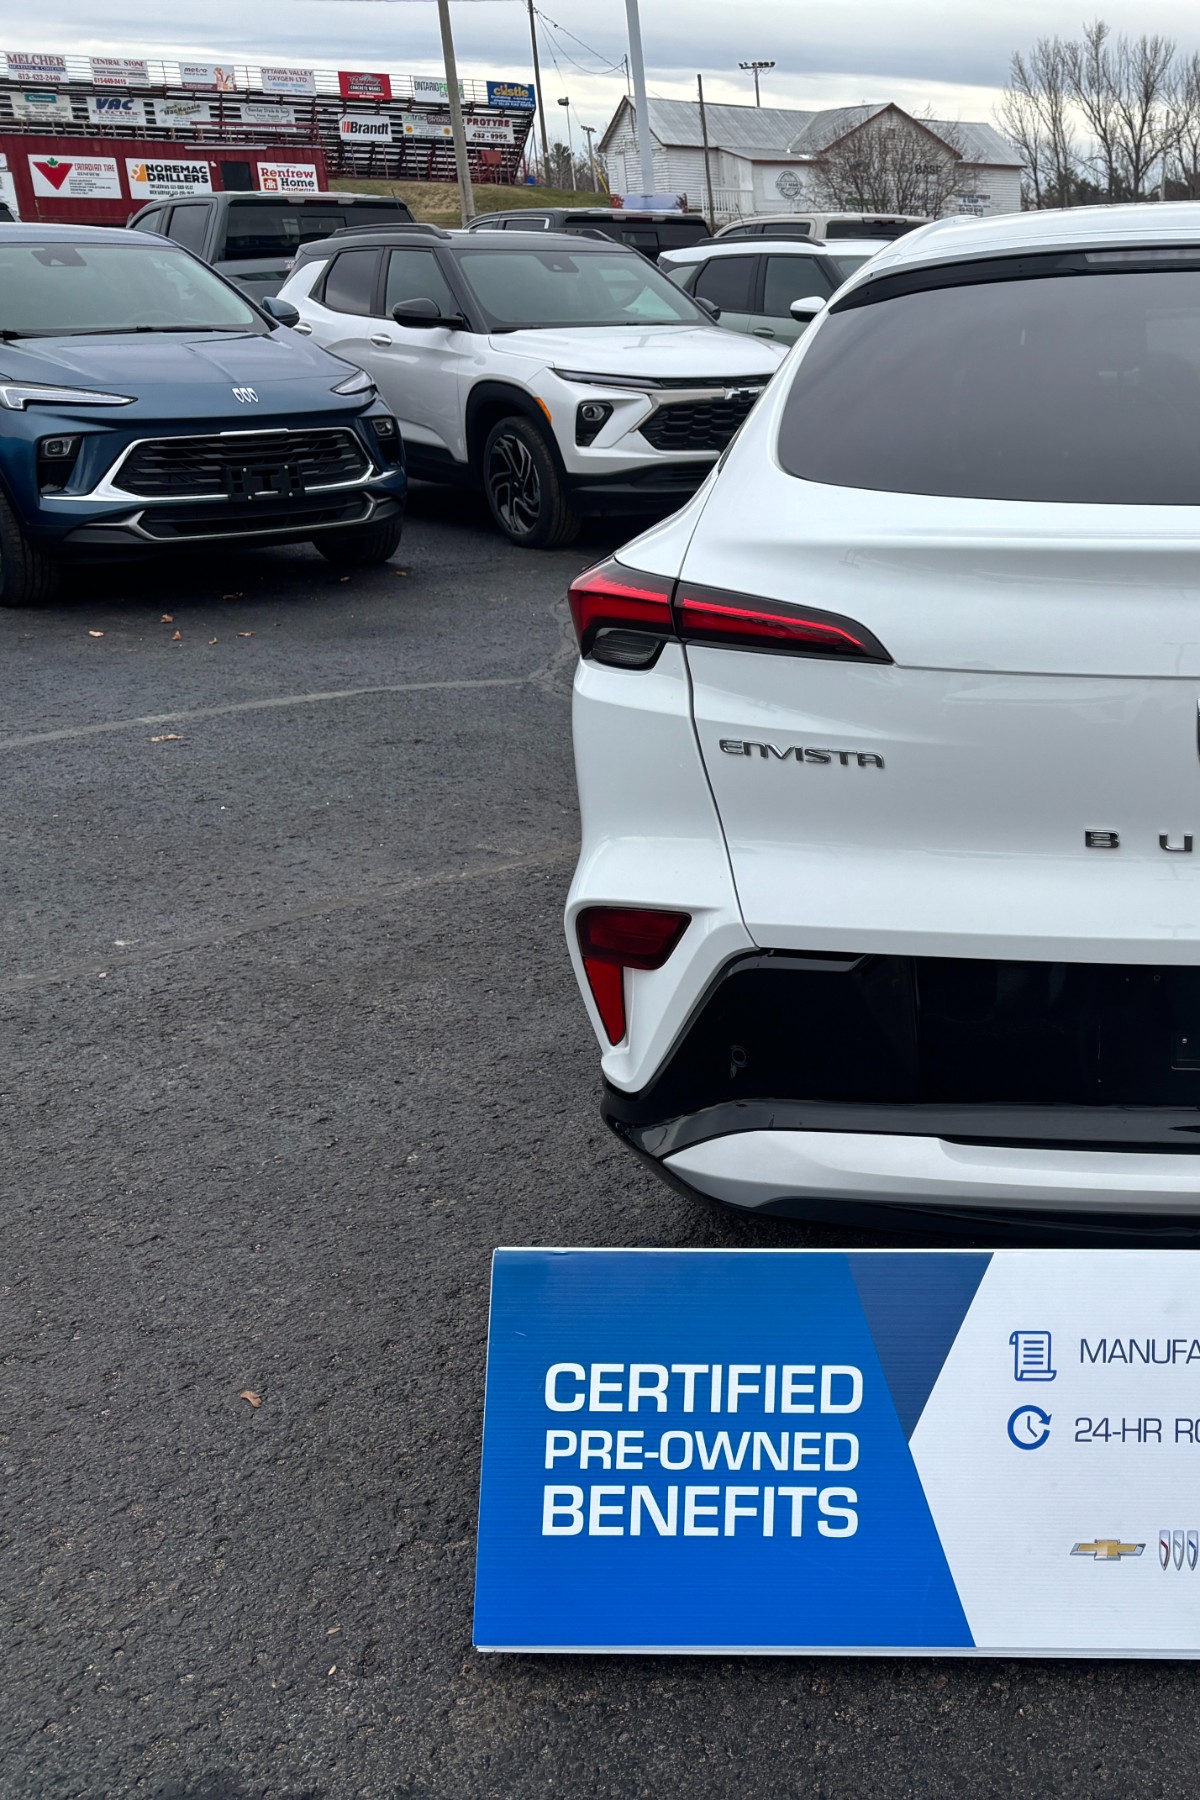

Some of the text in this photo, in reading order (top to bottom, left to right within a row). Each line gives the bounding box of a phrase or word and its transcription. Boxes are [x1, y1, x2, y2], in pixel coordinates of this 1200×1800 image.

[7, 55, 65, 66] MELCHER
[92, 58, 145, 67] CENTRAL STONE
[414, 81, 440, 92] ONTARIO
[493, 84, 529, 98] castle
[95, 97, 135, 111] VAC
[351, 121, 389, 135] Brandt
[467, 118, 510, 128] PROTYRE
[74, 163, 115, 173] CANADIAN TIRE
[145, 164, 208, 175] NOREMAC
[260, 167, 314, 179] Renfrew
[146, 173, 209, 184] DRILLERS
[280, 178, 315, 188] Home
[719, 738, 885, 769] ENVISTA
[544, 1362, 864, 1414] CERTIFIED
[1074, 1416, 1162, 1444] 24-HR
[544, 1430, 860, 1471] PRE-OWNED
[542, 1485, 859, 1538] BENEFITS
